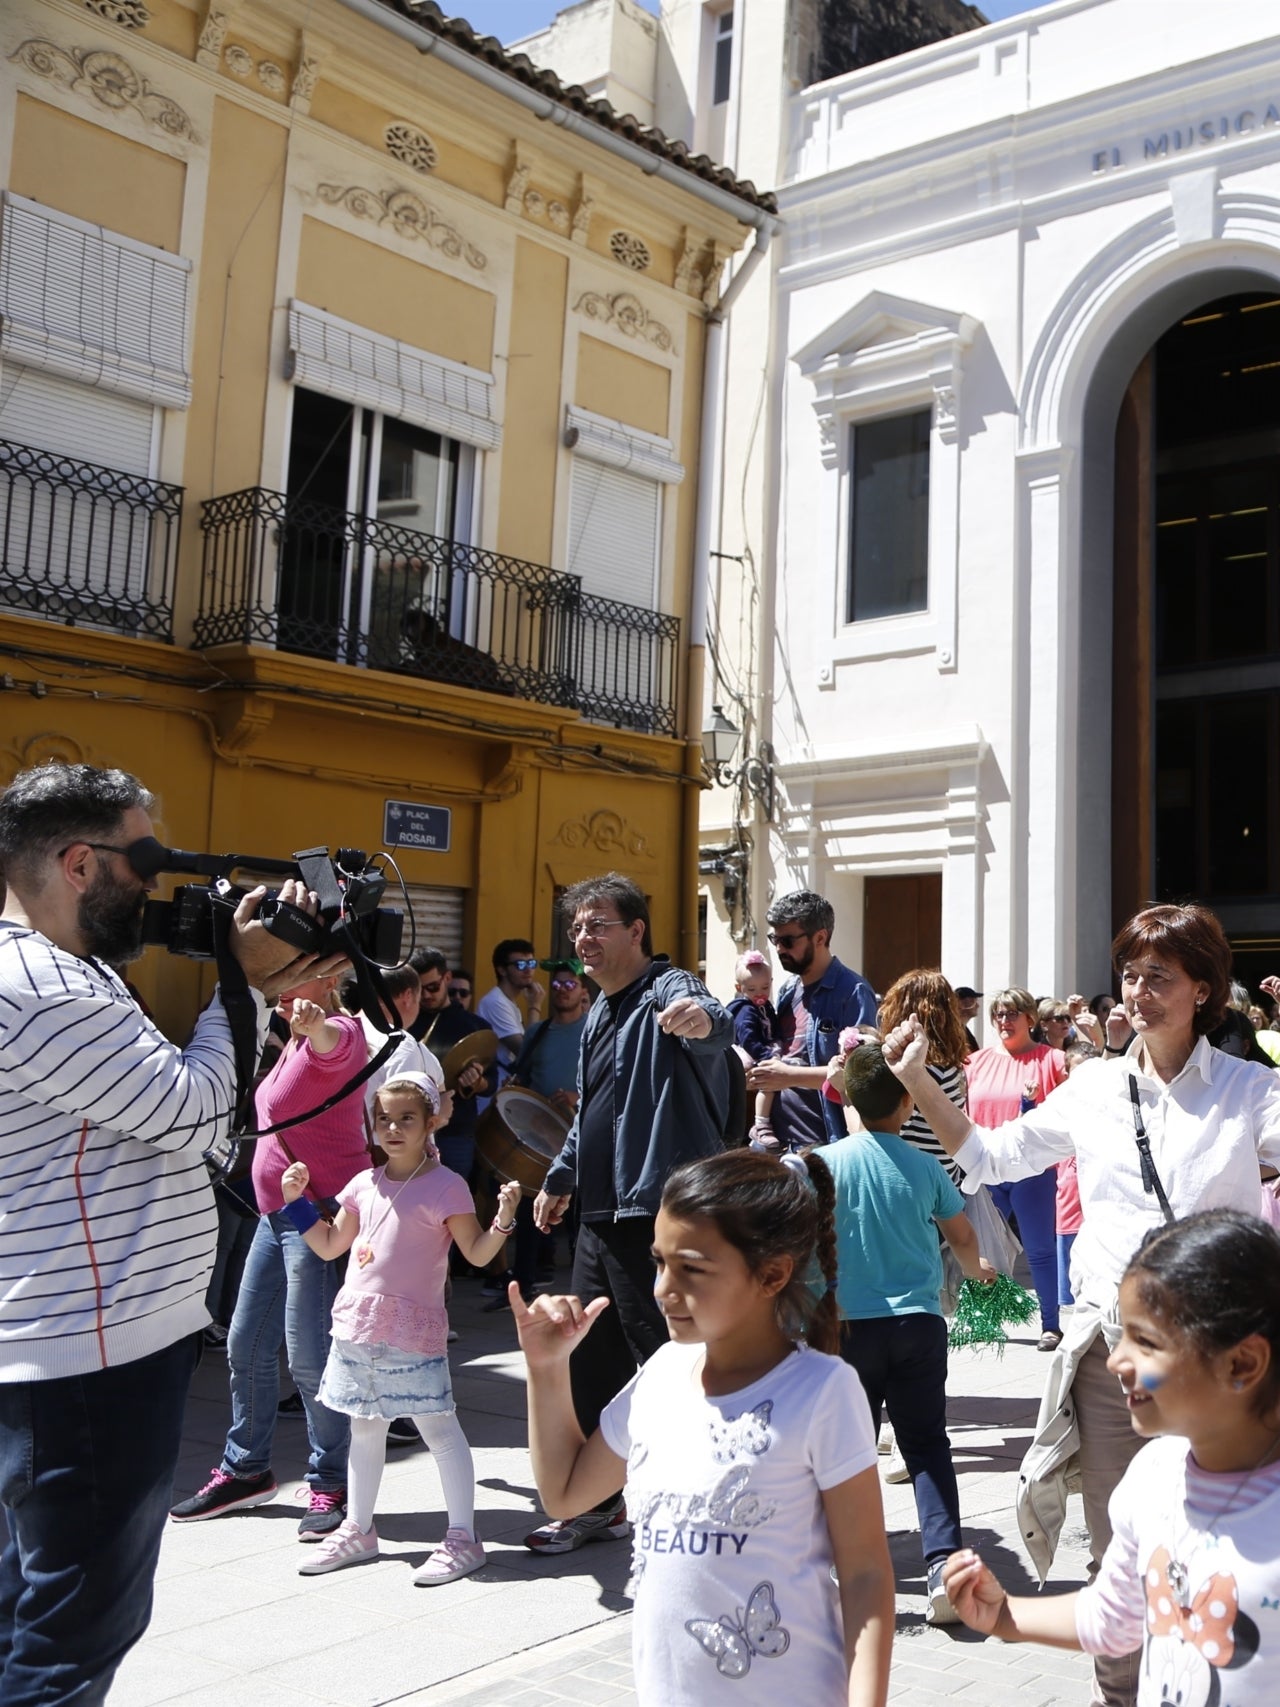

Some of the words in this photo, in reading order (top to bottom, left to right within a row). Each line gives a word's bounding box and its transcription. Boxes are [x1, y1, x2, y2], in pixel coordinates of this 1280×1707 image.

[1092, 147, 1125, 175] EL
[410, 822, 425, 831] DEL
[399, 832, 436, 845] ROSARI
[289, 913, 313, 932] SONY
[641, 1526, 749, 1556] BEAUTY
